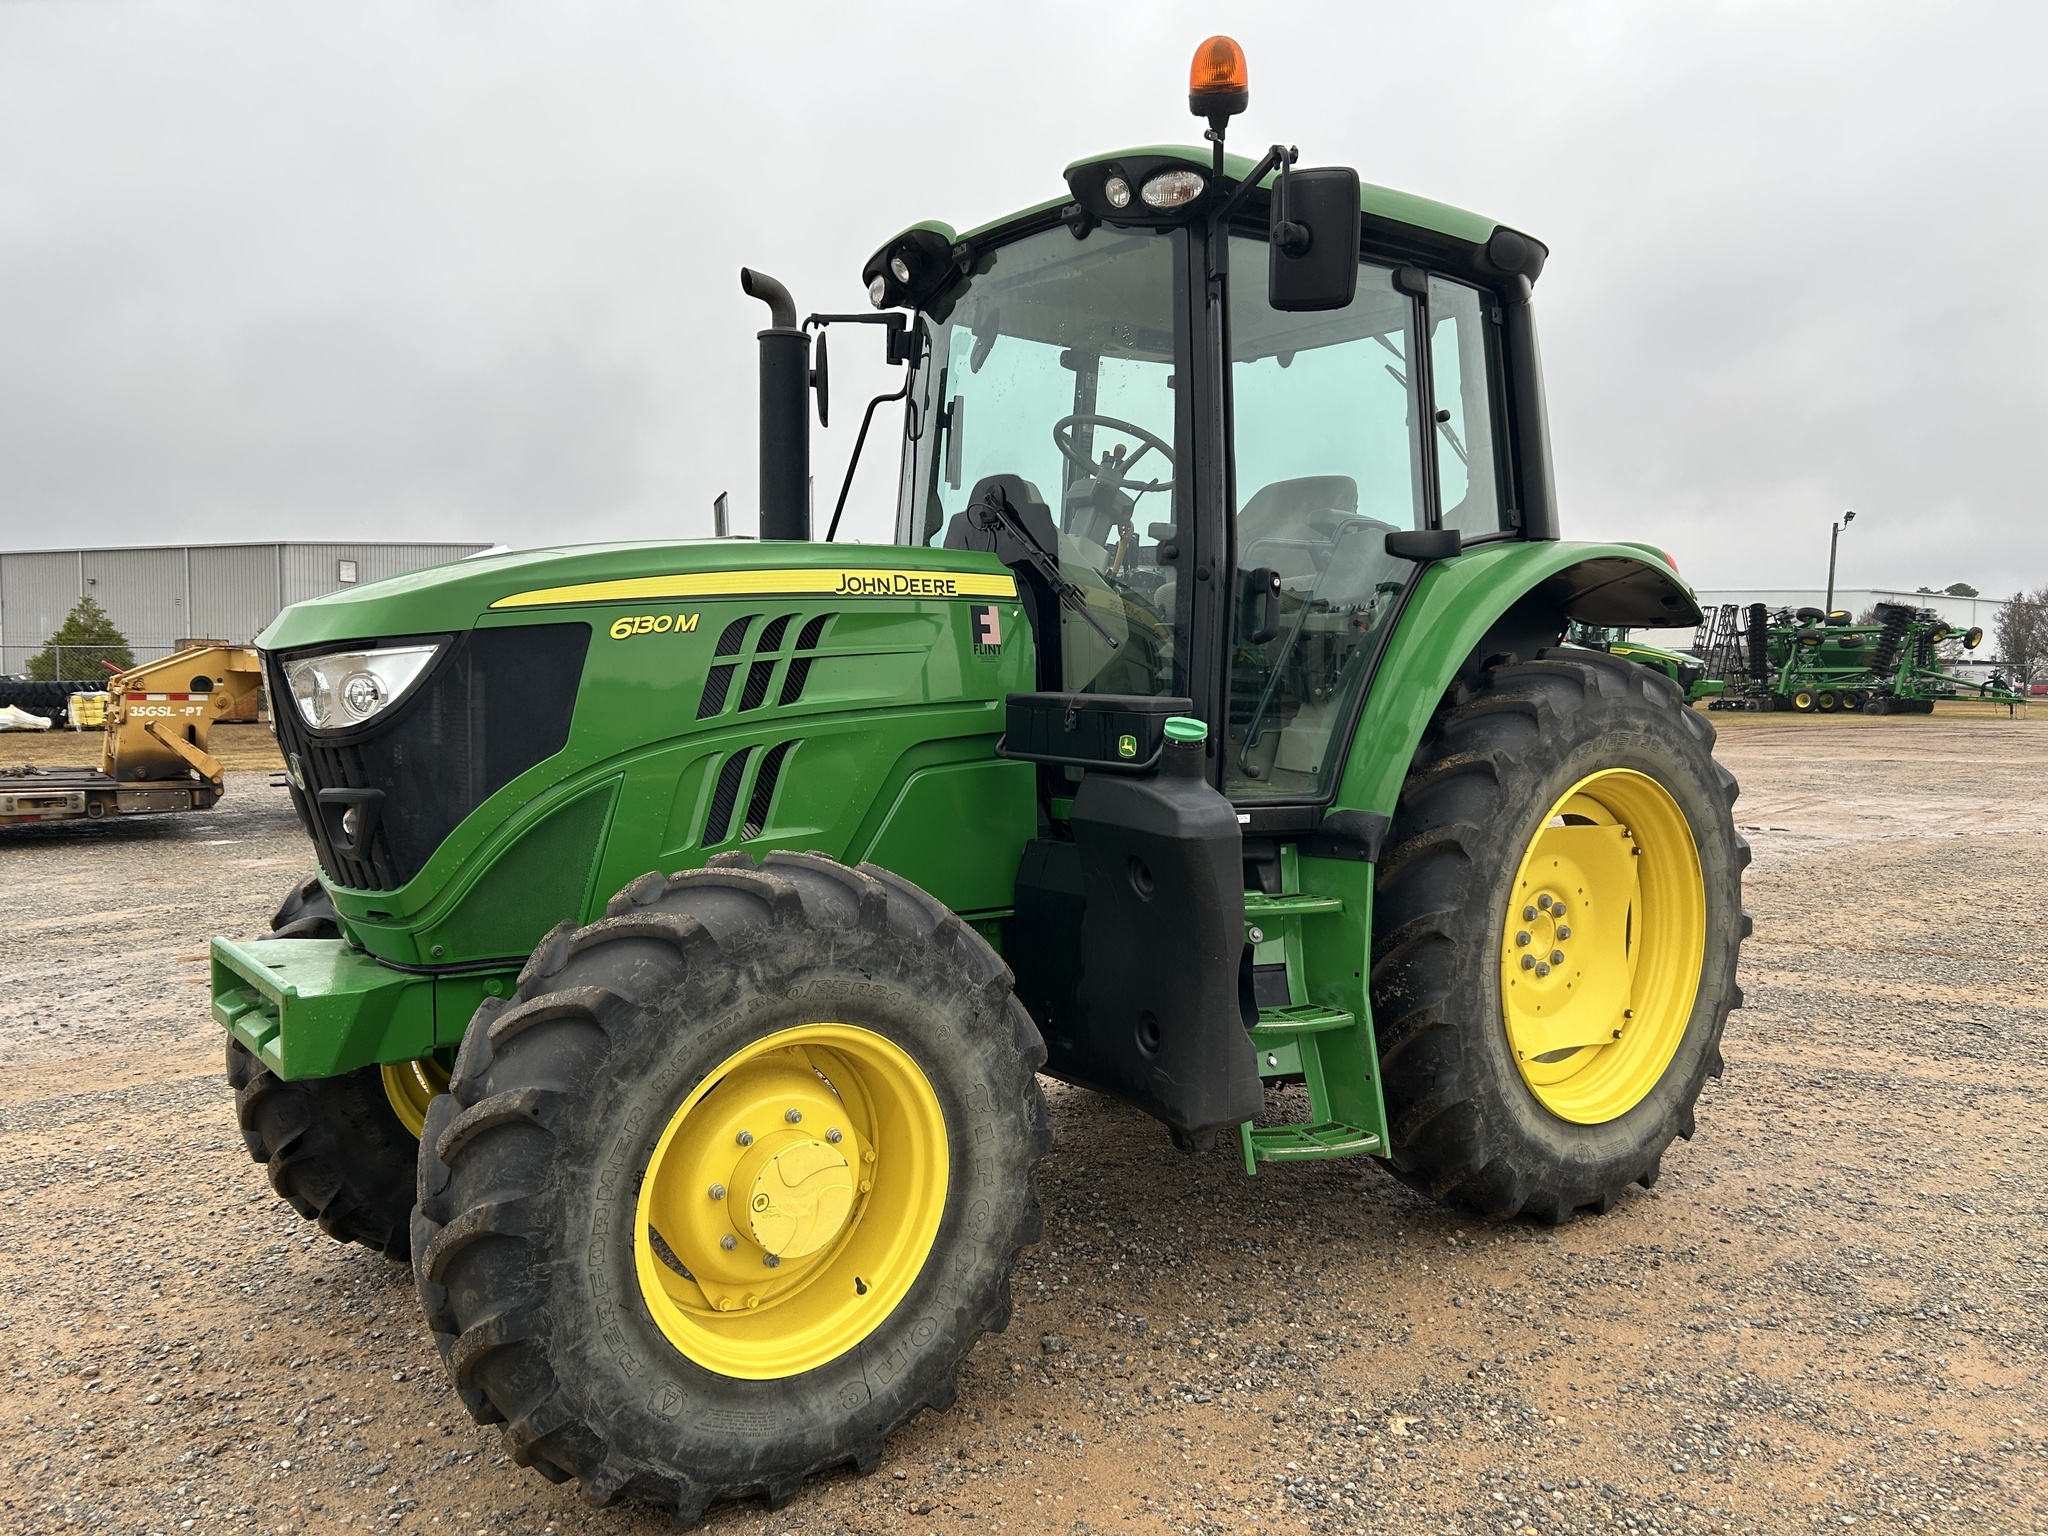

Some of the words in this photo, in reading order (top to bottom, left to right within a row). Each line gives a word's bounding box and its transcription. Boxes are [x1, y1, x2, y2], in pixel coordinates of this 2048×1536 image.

[836, 573, 891, 593] JOHN
[893, 574, 957, 594] DEERE
[973, 644, 1002, 656] FLINT
[588, 1105, 645, 1378] PERFORMER
[696, 1011, 742, 1045] EXTRA
